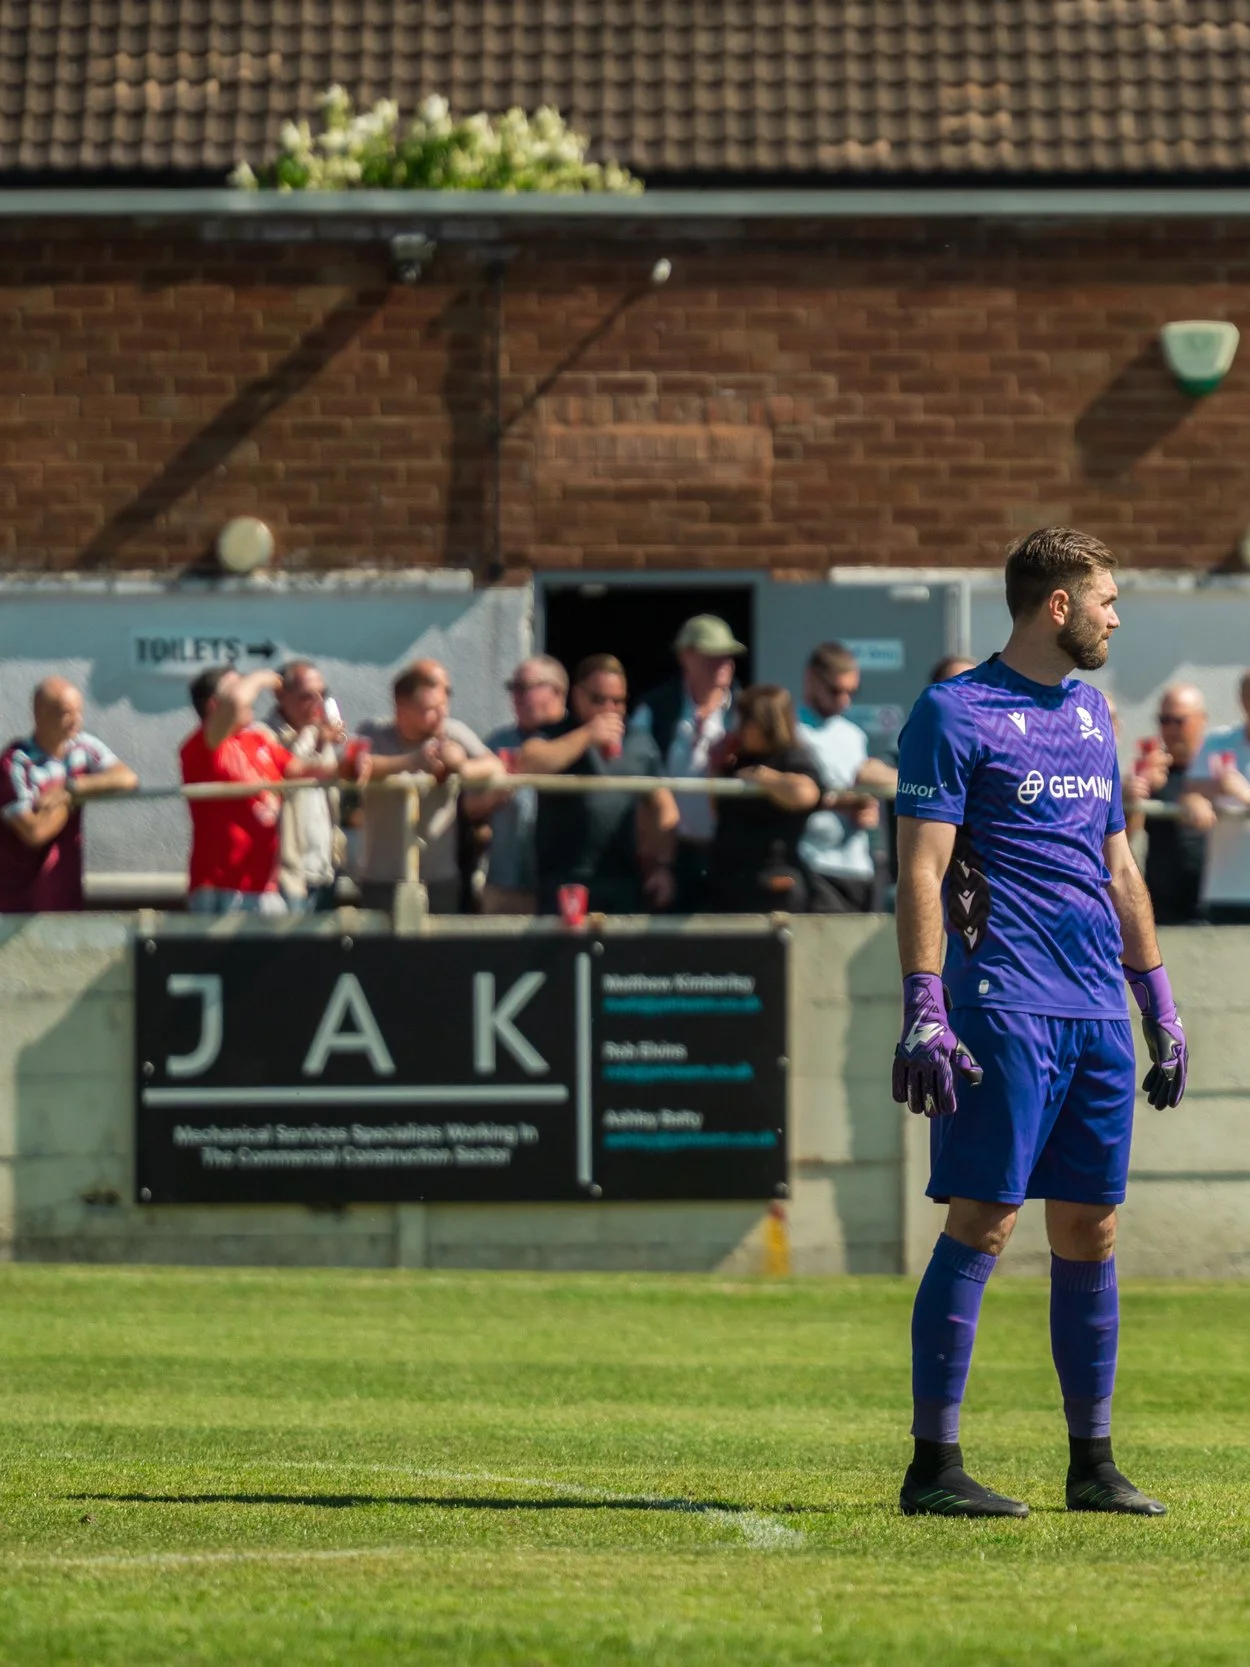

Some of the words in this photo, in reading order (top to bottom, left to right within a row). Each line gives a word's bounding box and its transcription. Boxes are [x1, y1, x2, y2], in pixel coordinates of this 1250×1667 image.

[135, 635, 242, 663] TOILETS
[1048, 775, 1113, 802] GEMINI
[173, 1123, 271, 1147] Mechanical
[274, 1123, 348, 1147] Services
[350, 1122, 443, 1147] Specialists
[446, 1121, 518, 1149] Working
[519, 1121, 539, 1145] In
[201, 1145, 234, 1169] The
[236, 1144, 339, 1169] Commercial
[341, 1144, 452, 1169] Construction
[454, 1144, 512, 1169] Sector
